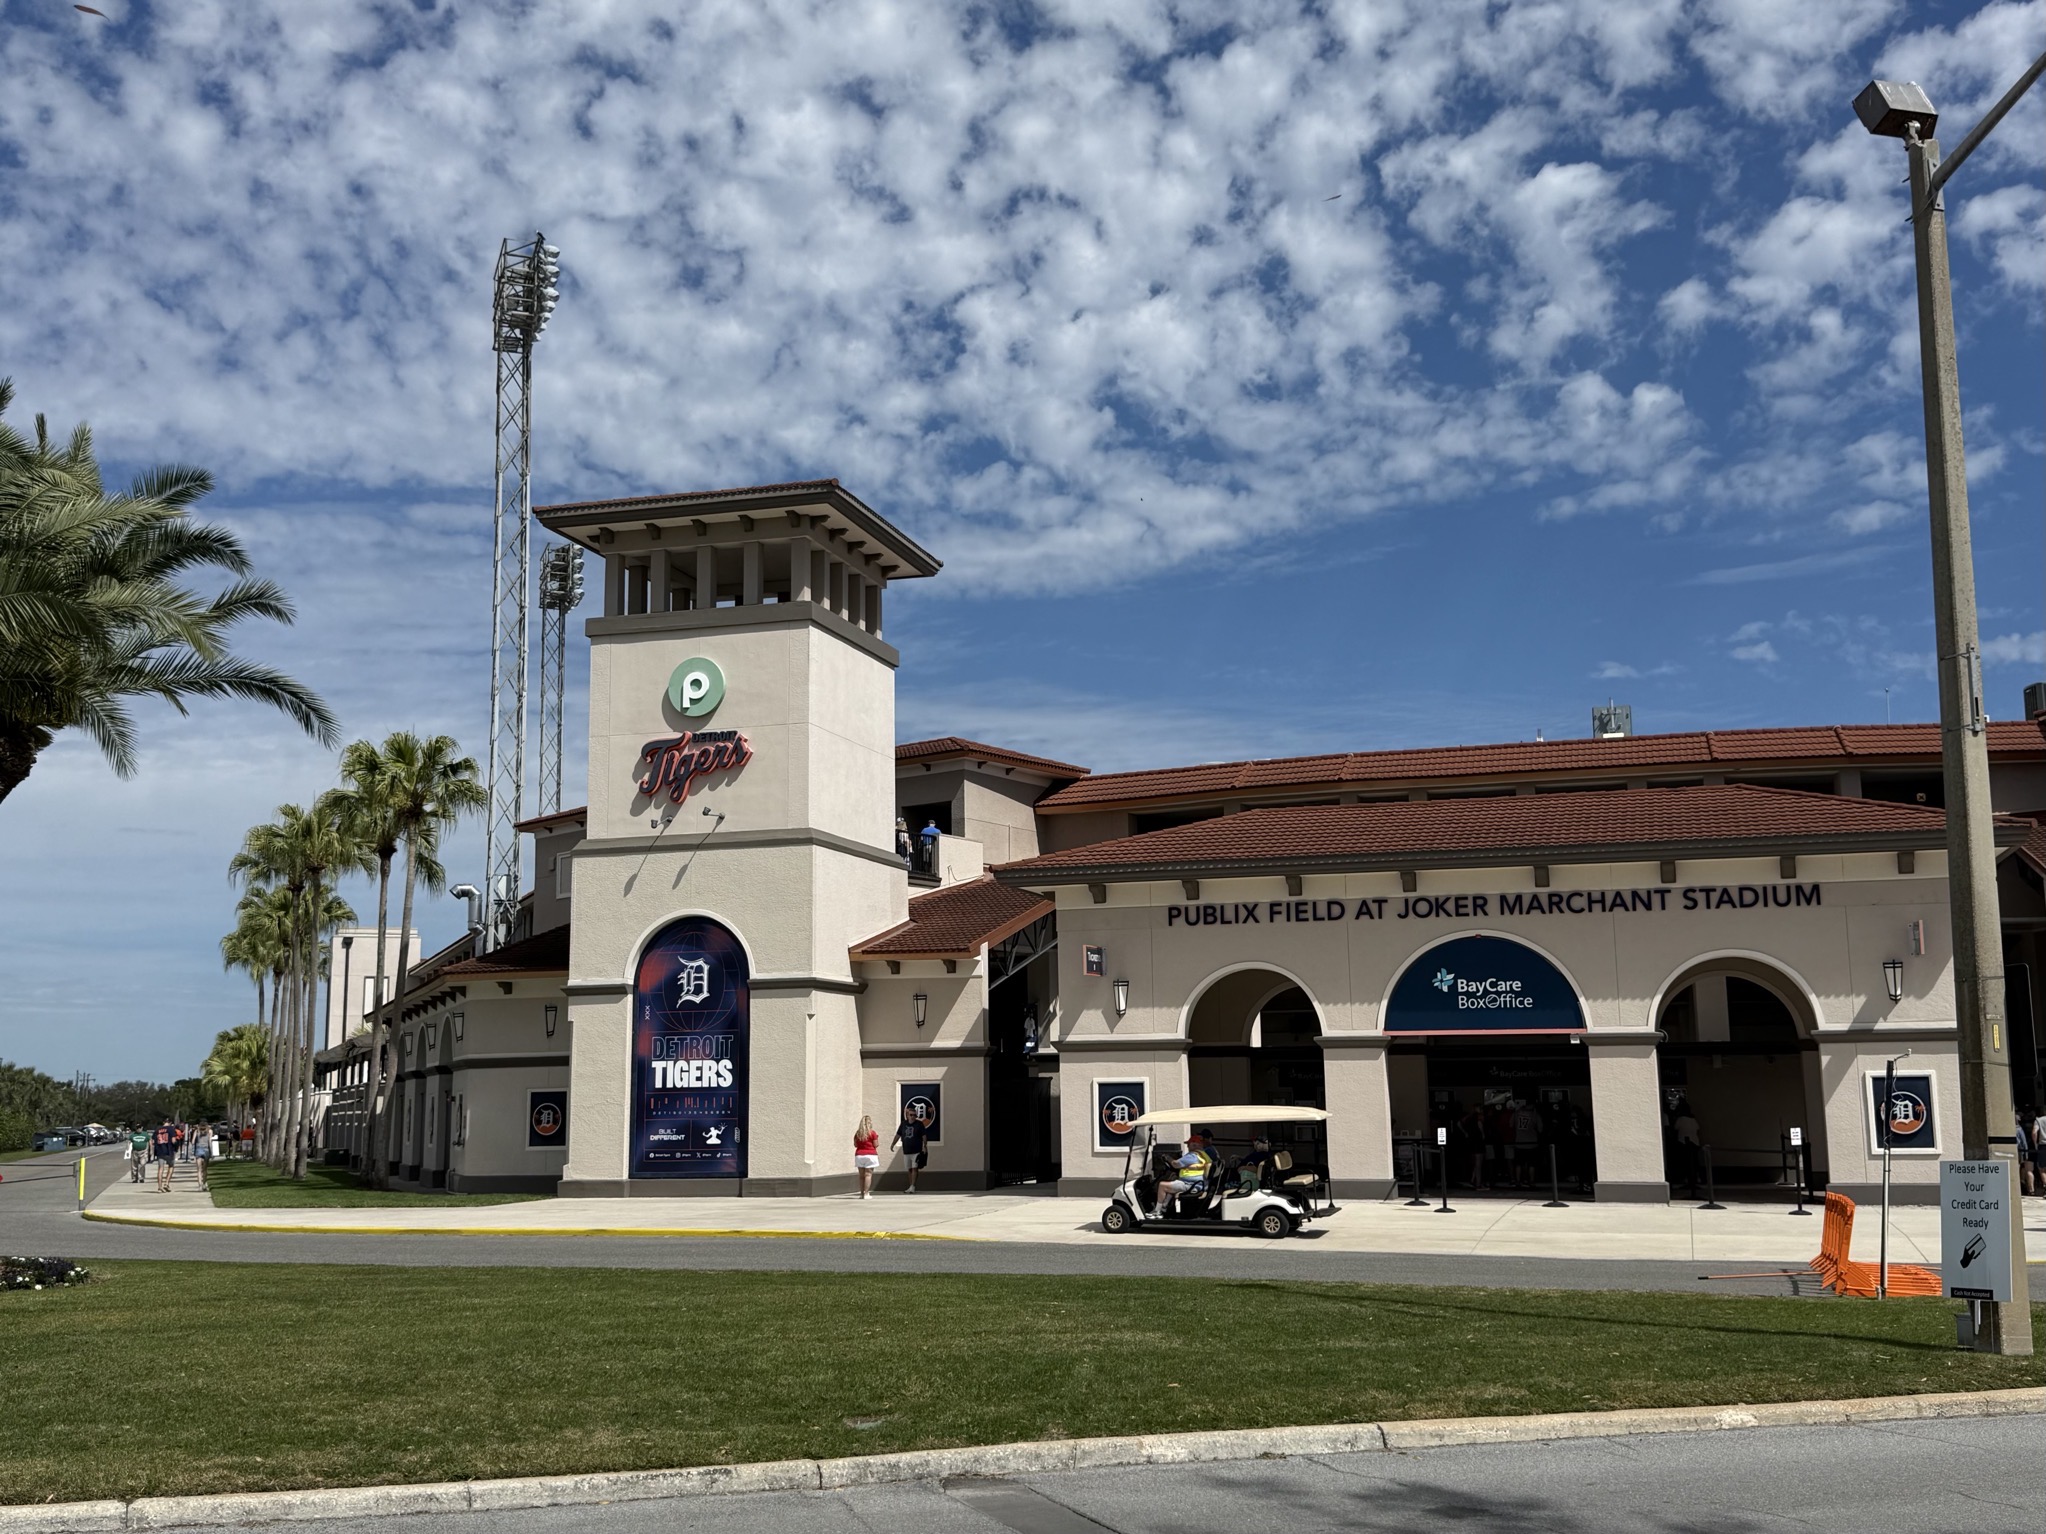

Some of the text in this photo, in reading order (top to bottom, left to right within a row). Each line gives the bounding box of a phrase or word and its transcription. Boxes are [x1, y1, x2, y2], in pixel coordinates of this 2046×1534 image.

[691, 730, 738, 743] DETROIT
[638, 731, 754, 804] Tigers
[1168, 883, 1822, 927] PUBLIX FIELD AT JOKER MARCHANT STADIUM
[1457, 977, 1522, 996] BayCare
[651, 1034, 734, 1060] DETROIT
[651, 1059, 733, 1089] TIGERS
[1949, 1163, 2000, 1174] Please Have
[1963, 1181, 1985, 1192] Your
[1951, 1199, 1999, 1210] Credit Card
[1962, 1217, 1989, 1231] Ready
